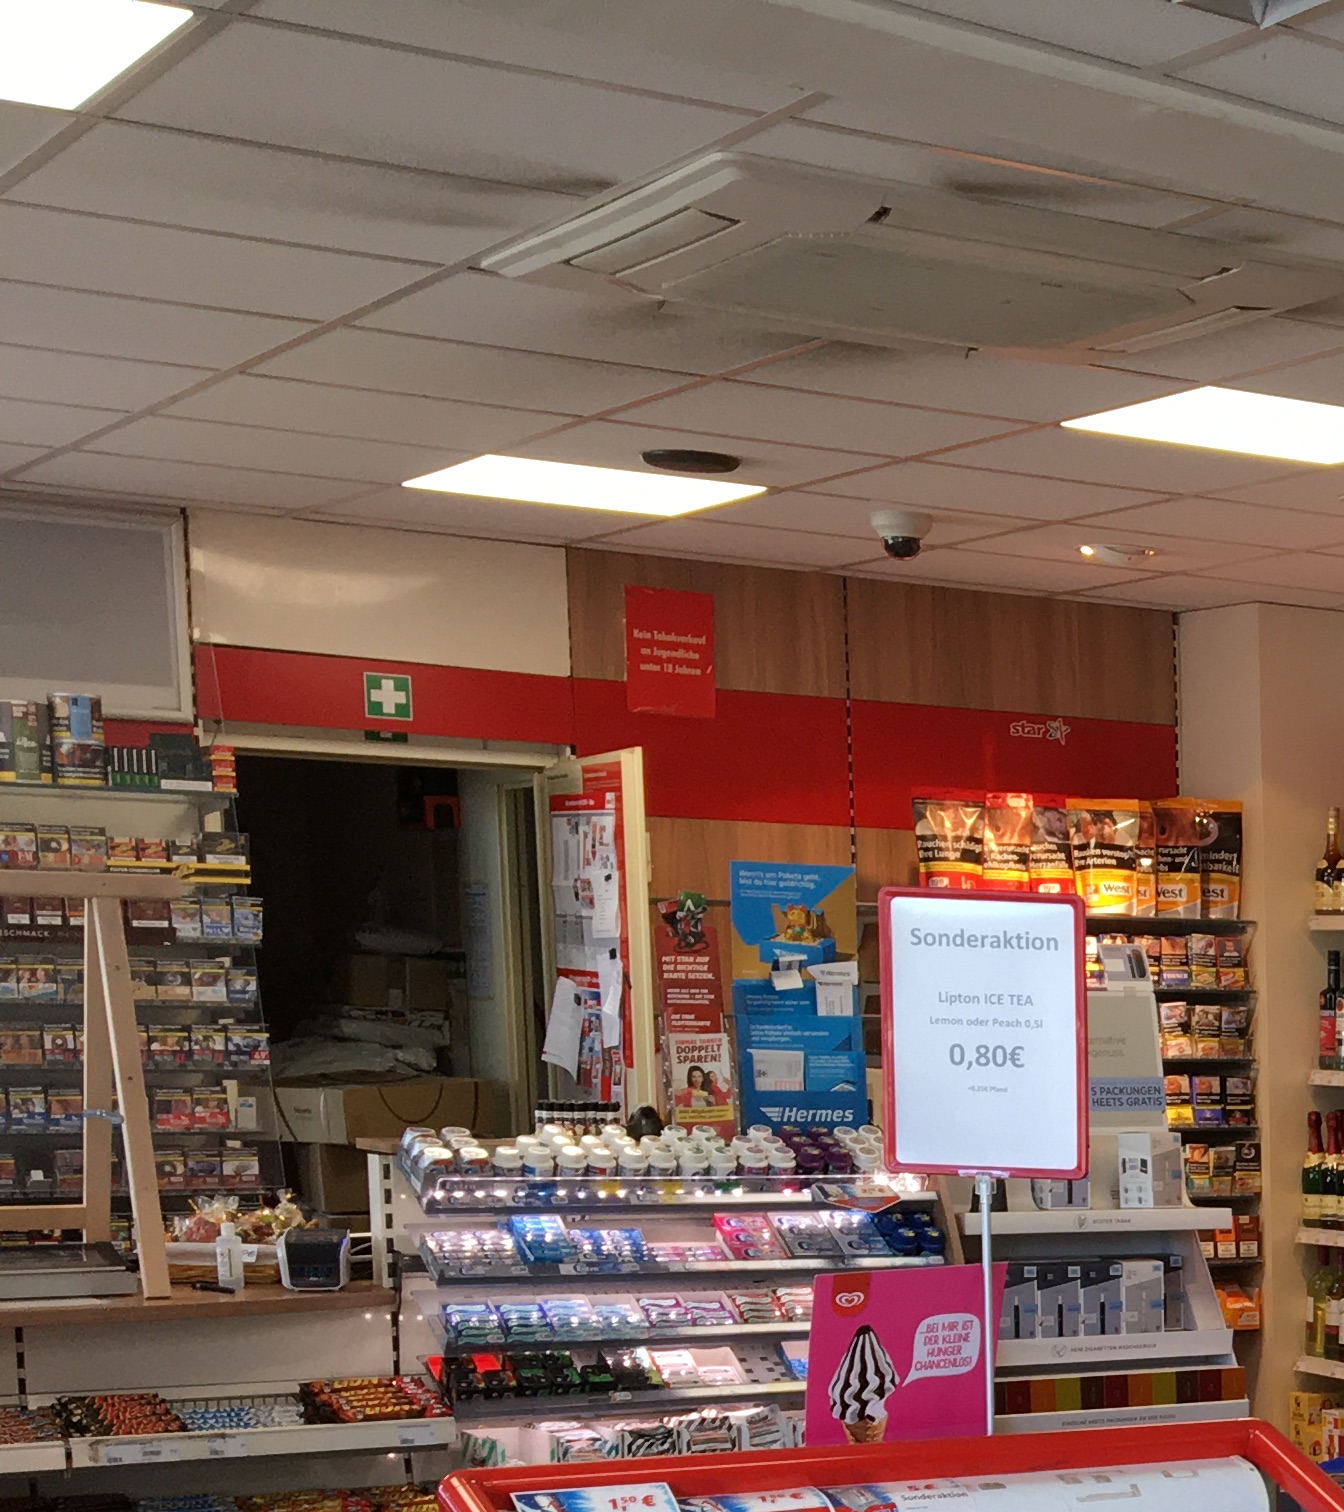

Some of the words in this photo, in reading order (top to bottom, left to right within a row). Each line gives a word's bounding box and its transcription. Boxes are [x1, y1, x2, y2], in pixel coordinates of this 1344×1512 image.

[1010, 720, 1045, 738] star
[1102, 883, 1131, 894] West
[1202, 888, 1227, 899] est
[910, 927, 1059, 951] Sonderaktion
[938, 992, 980, 1008] Lipton
[984, 993, 1004, 1005] ICE
[1008, 994, 1034, 1007] TEA
[929, 1015, 963, 1026] Lemon
[966, 1016, 989, 1027] oder
[992, 1018, 1022, 1029] Peach
[676, 1043, 722, 1055] DOPPELT
[677, 1053, 721, 1064] SPAREN!
[949, 1043, 1025, 1071] 0,80€
[1091, 1086, 1097, 1096] 5
[1099, 1086, 1161, 1096] PACKUNGEN
[1092, 1097, 1124, 1107] HEETS
[1126, 1097, 1163, 1107] GRATIS
[782, 1107, 854, 1123] Hermes
[941, 1322, 958, 1333] MIR
[961, 1320, 974, 1331] IST
[923, 1335, 939, 1346] DER
[941, 1332, 971, 1344] KLEINE
[926, 1345, 963, 1357] HUNGER
[914, 1357, 972, 1371] CHANCENLOS!
[900, 1490, 969, 1503] Sonderaktion
